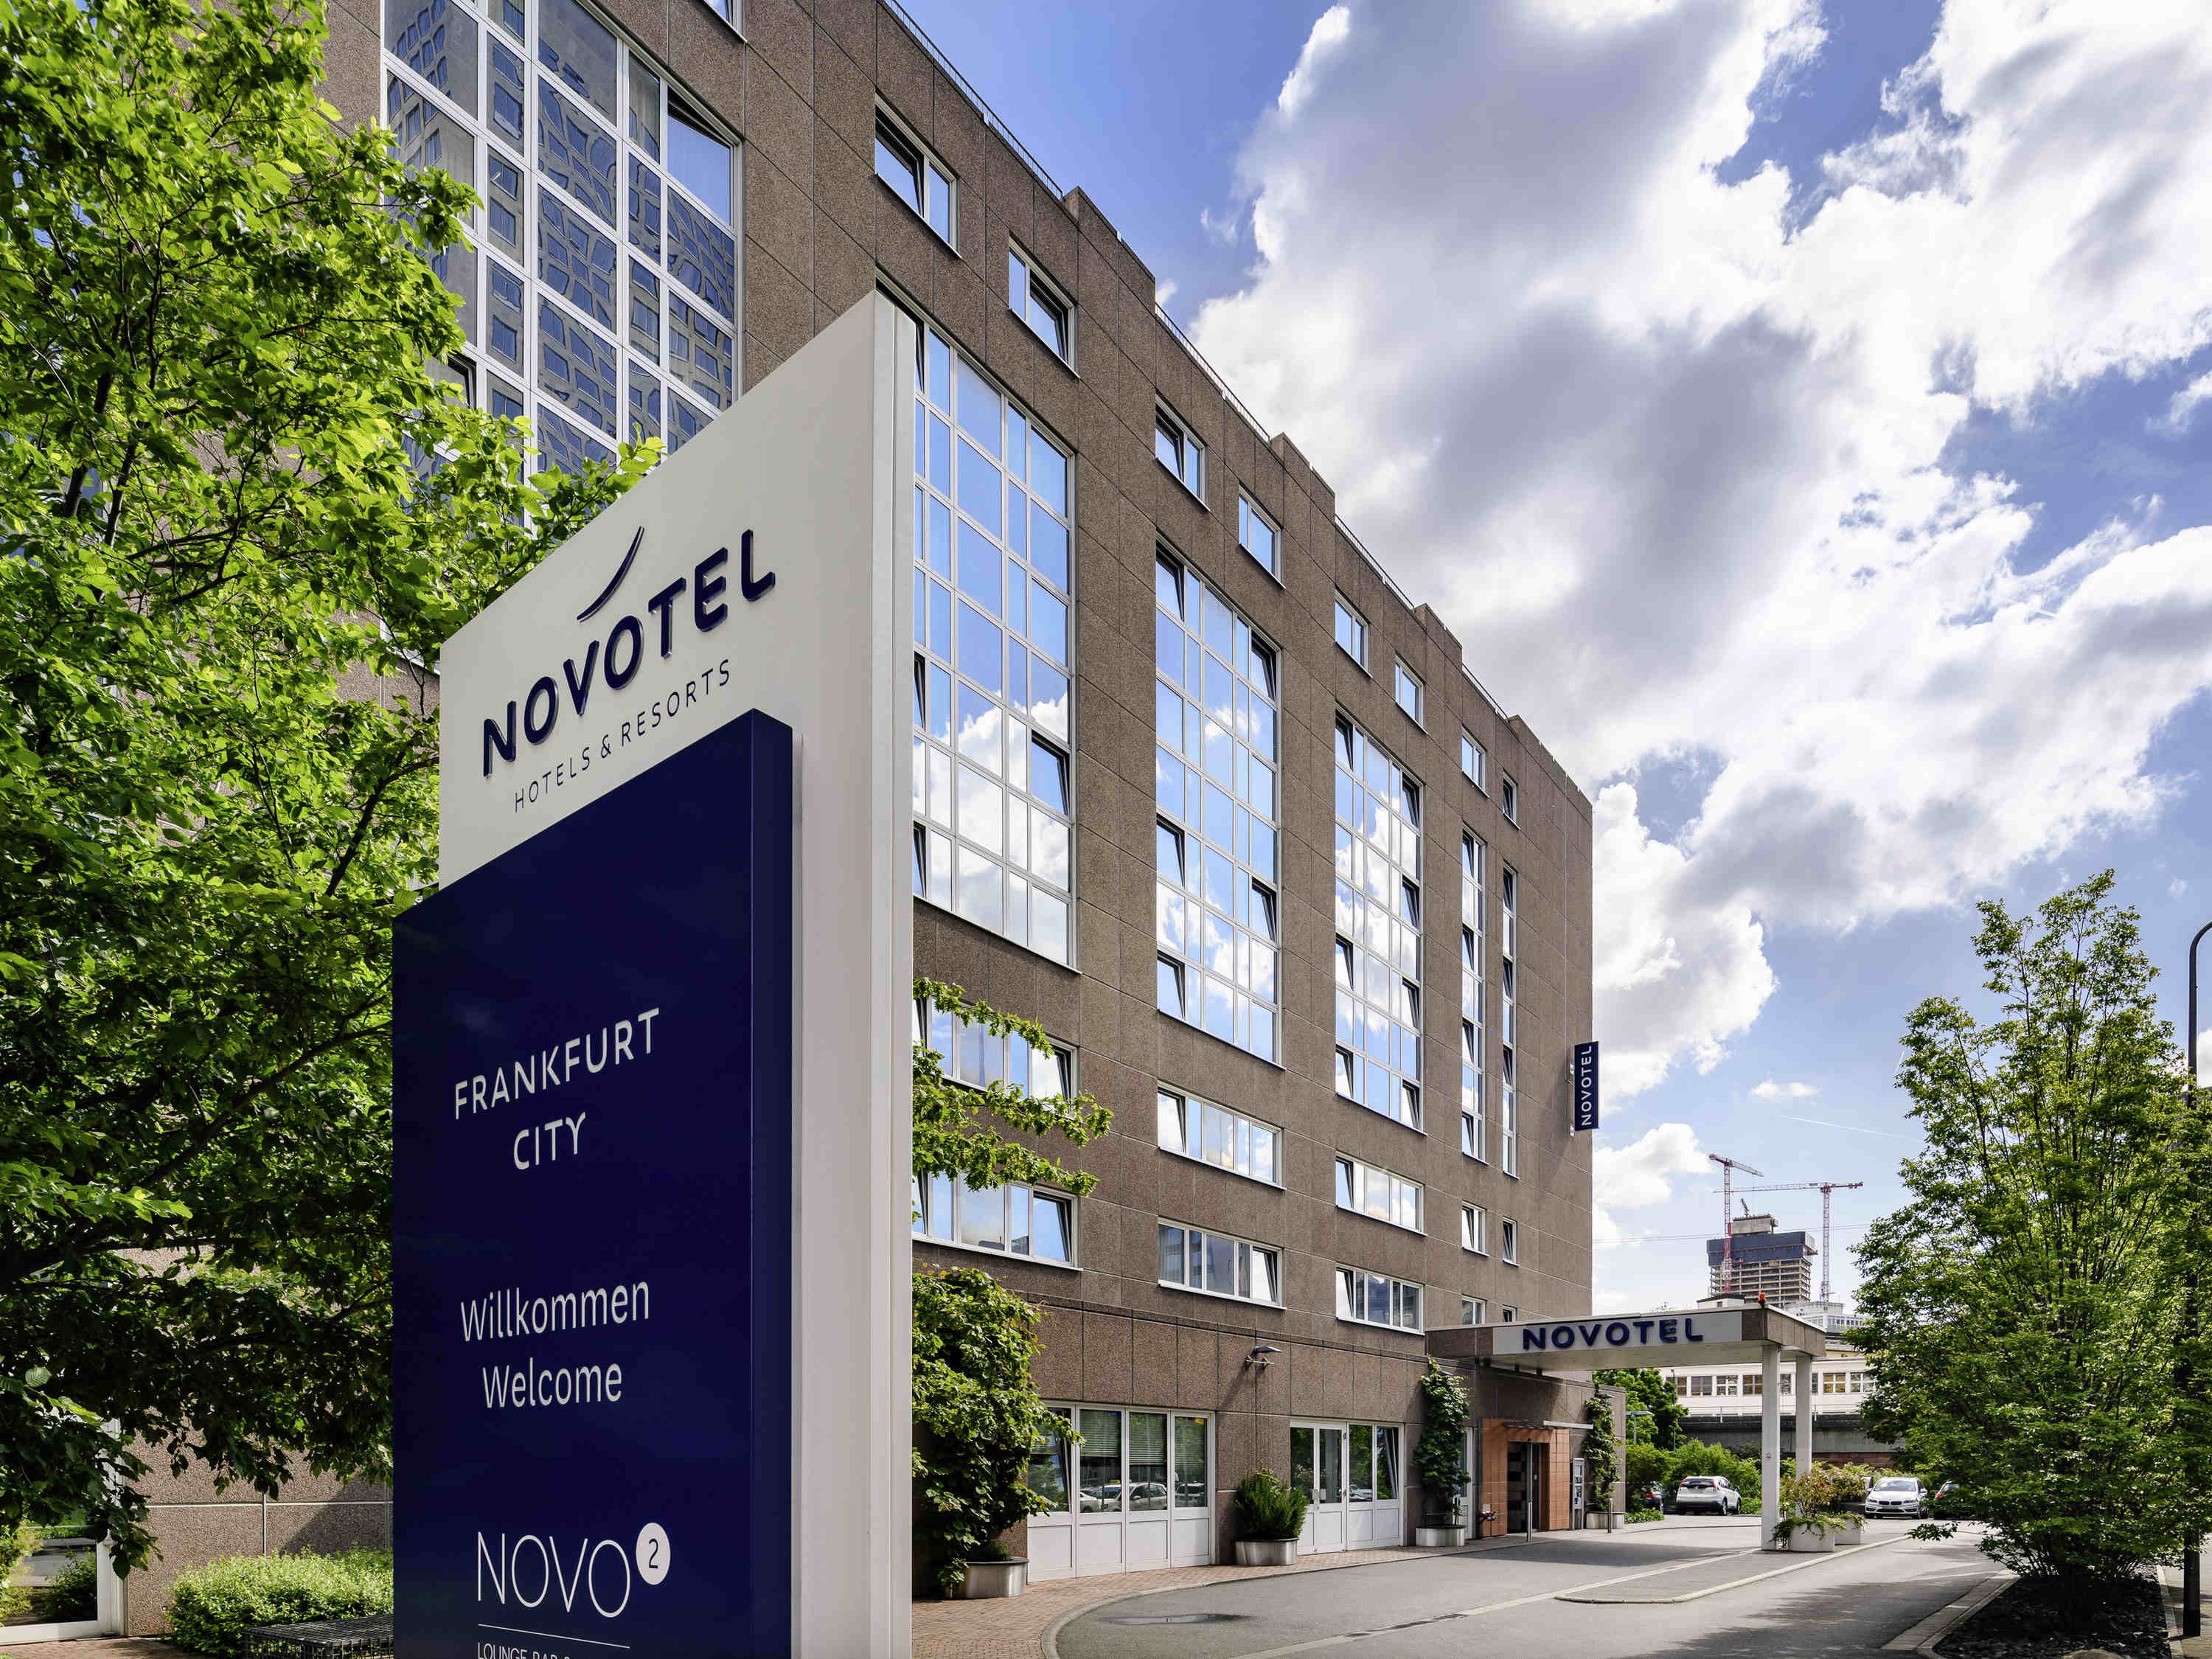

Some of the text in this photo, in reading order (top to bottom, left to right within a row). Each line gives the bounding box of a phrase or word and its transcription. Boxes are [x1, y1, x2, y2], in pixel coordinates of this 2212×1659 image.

[483, 529, 776, 779] NOVOTEL
[515, 658, 730, 813] HOTELS & RESORTS
[455, 1007, 659, 1119] FRANKFURT
[1581, 1046, 1592, 1126] NOVOTEL
[513, 1111, 586, 1170] CITY
[460, 1281, 650, 1341] Willkommen
[1523, 1318, 1703, 1351] NOVOTEL
[482, 1357, 622, 1408] Welcome
